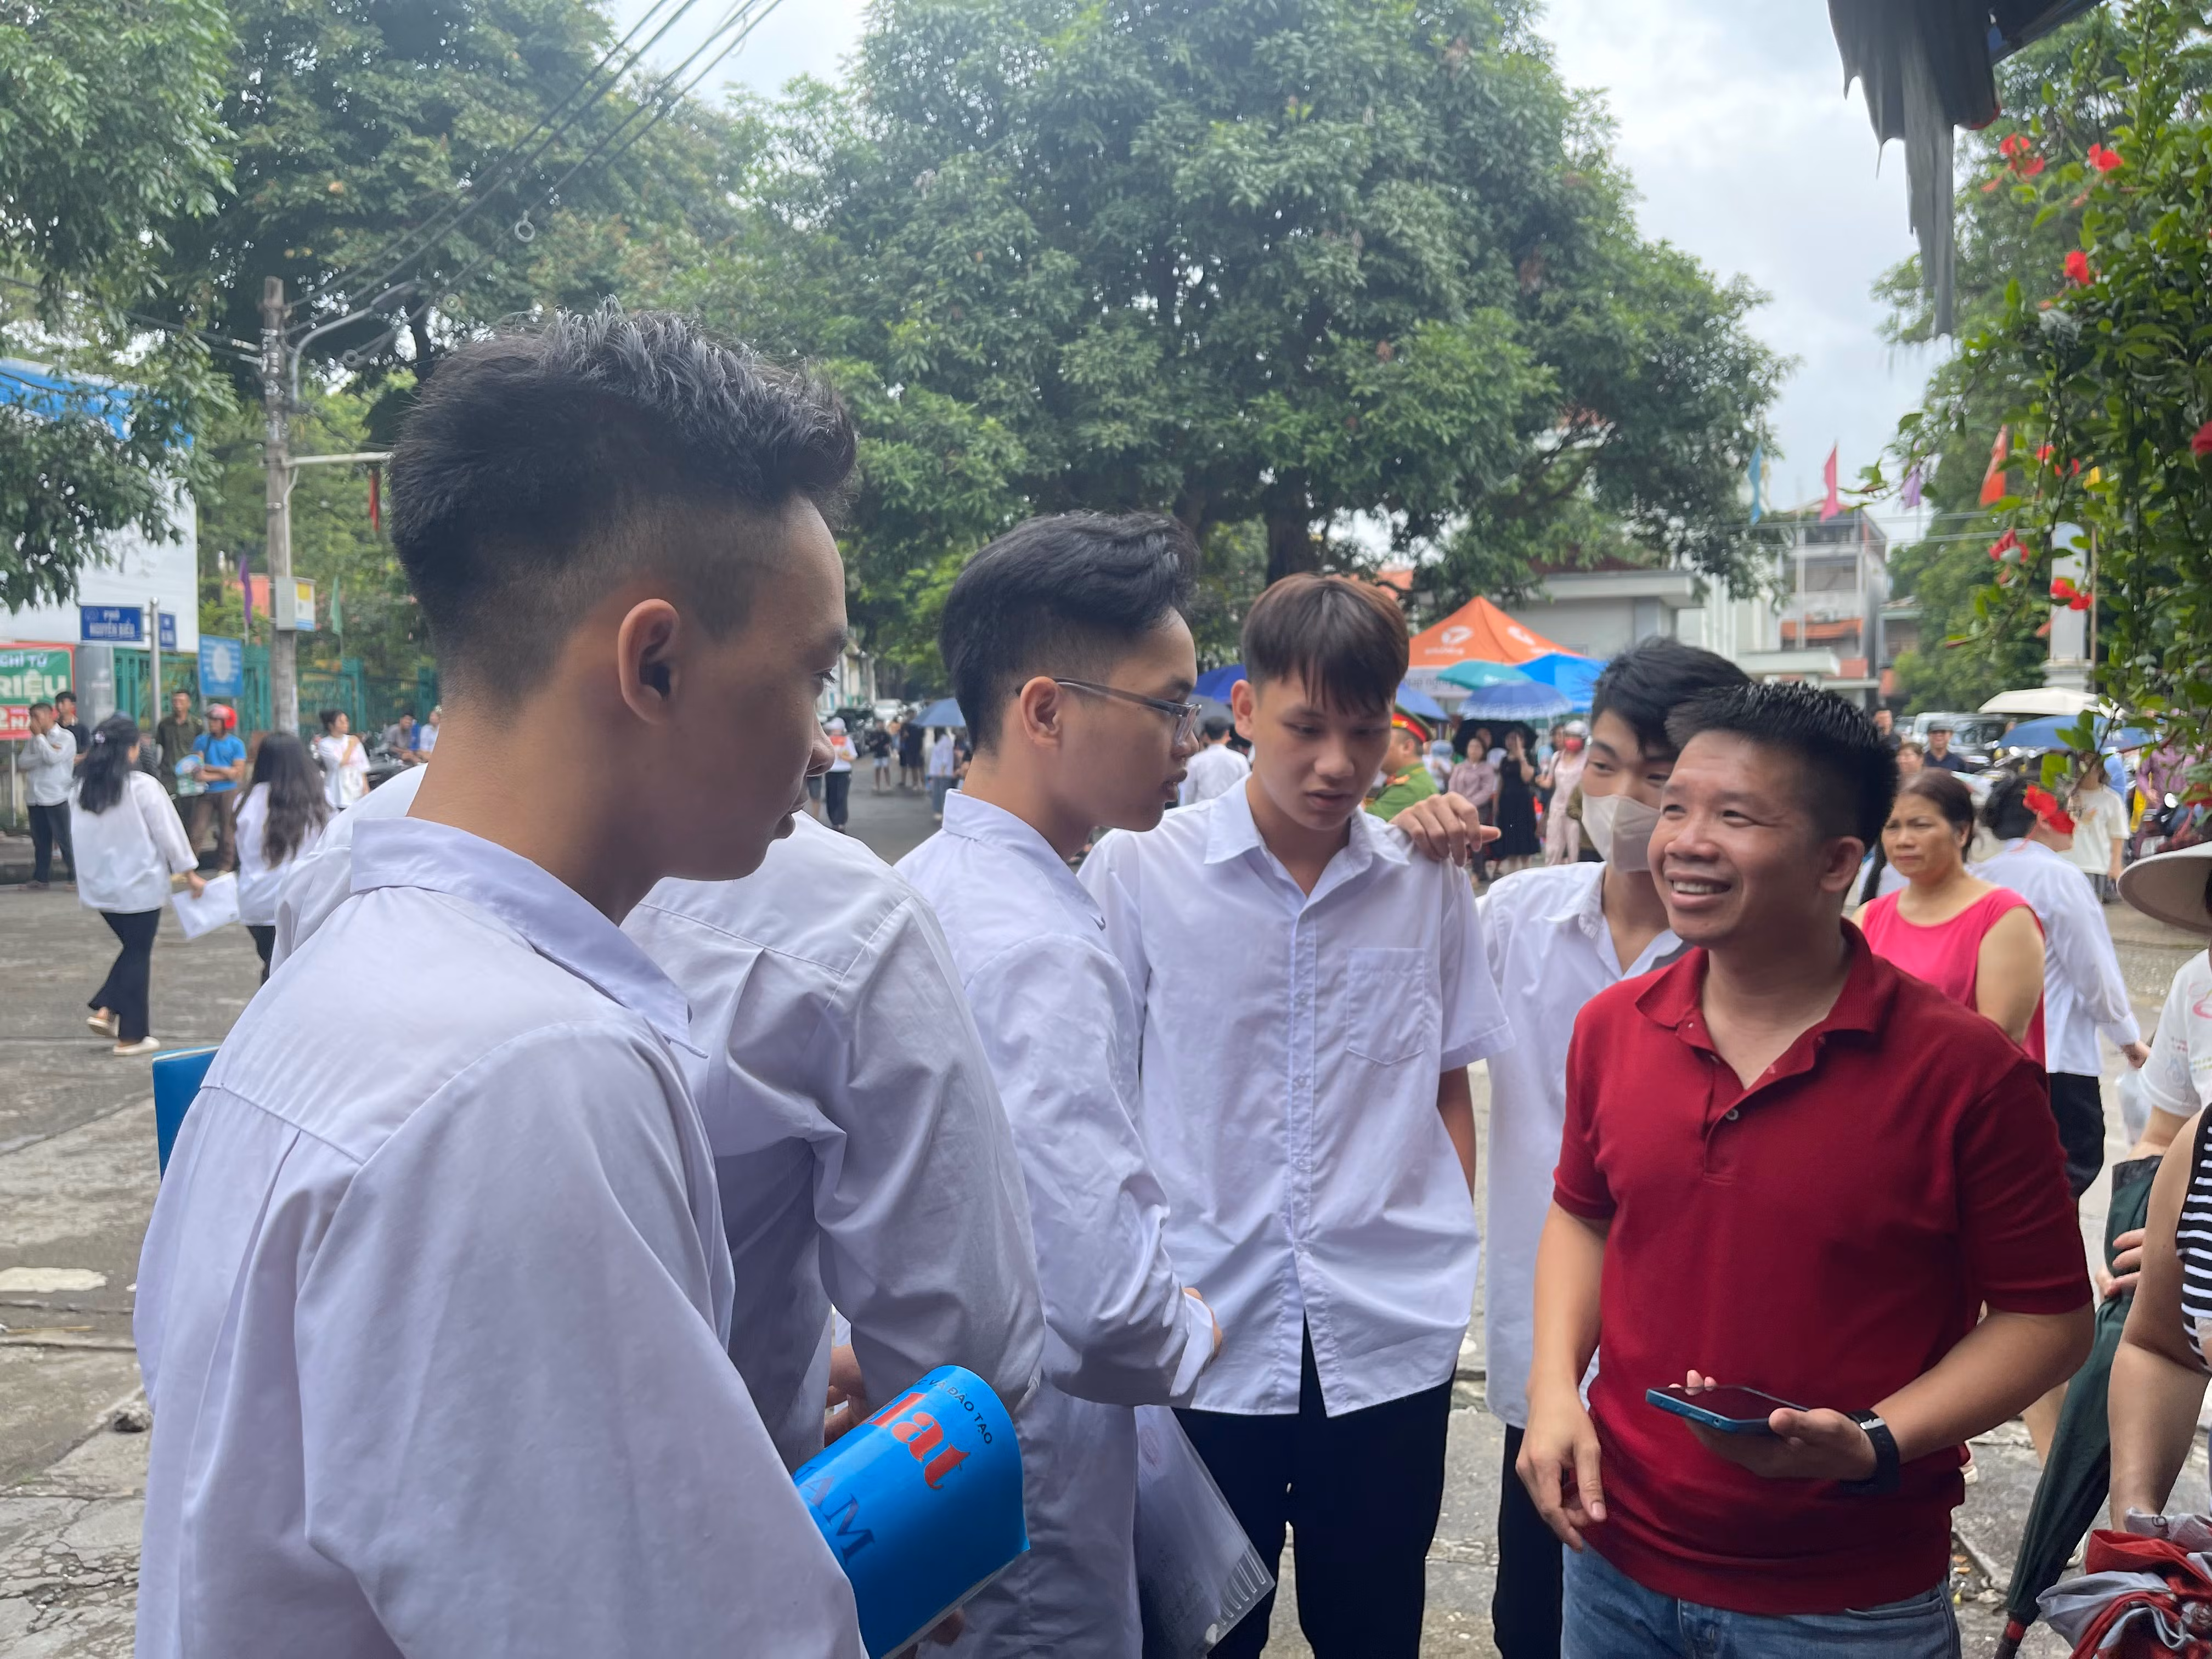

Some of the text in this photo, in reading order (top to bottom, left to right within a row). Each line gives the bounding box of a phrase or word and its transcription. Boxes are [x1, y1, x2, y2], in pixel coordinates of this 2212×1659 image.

[0, 669, 67, 704] RIỆU
[862, 1392, 970, 1490] lat
[947, 1386, 974, 1412] ĐÀO
[974, 1412, 992, 1444] TẠO
